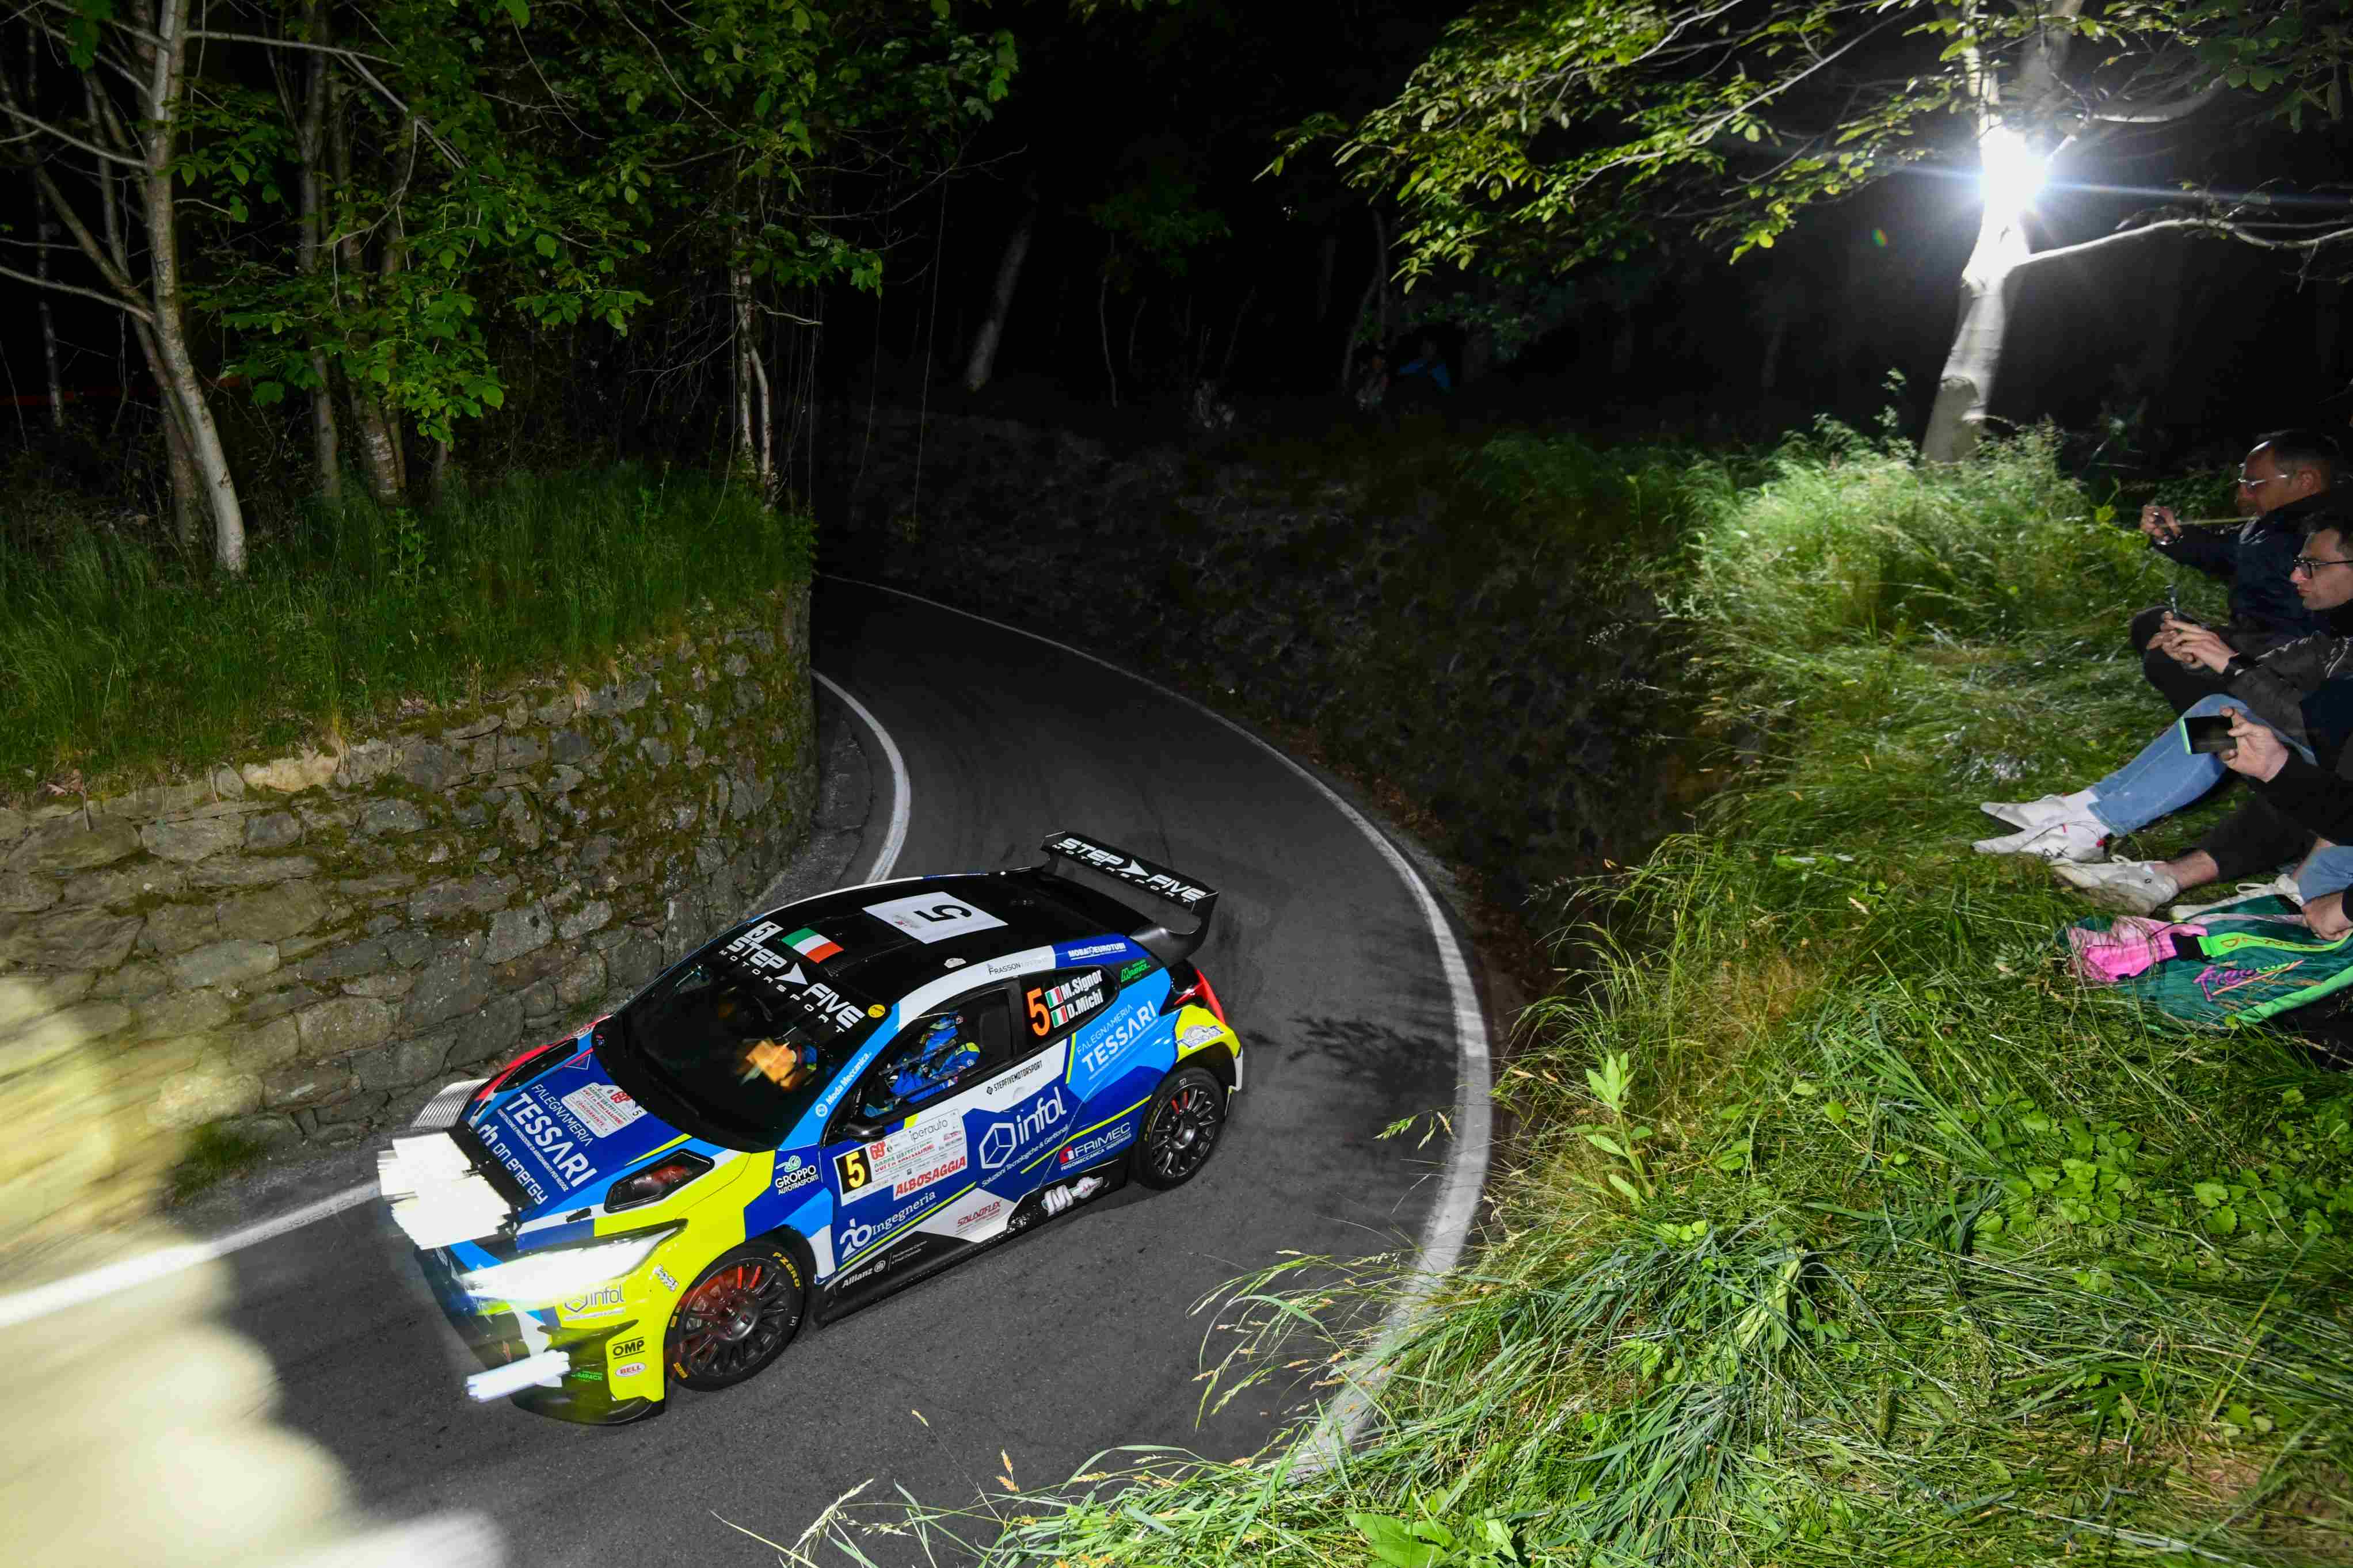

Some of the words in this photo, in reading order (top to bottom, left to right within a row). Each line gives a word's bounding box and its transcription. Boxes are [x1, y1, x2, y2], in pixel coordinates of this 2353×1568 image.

[1052, 844, 1191, 902] MOTORSPORT
[1058, 838, 1124, 865] STEP
[1146, 874, 1207, 902] FIVE
[914, 904, 972, 922] 5
[726, 936, 787, 970] STEP
[802, 982, 866, 1029] FIVE
[988, 963, 1021, 975] FRASSON
[1061, 970, 1103, 1001] M.Signor
[718, 950, 845, 1033] MOTORSPORT
[1067, 991, 1104, 1019] D.Michi
[1027, 987, 1051, 1036] 5
[1076, 1004, 1134, 1055] FALEGNAMERIA
[1081, 1000, 1157, 1073] TESSARI
[531, 1084, 594, 1147] FALEGNAMERIA
[909, 1119, 949, 1142] iperauto
[1016, 1086, 1067, 1144] infol
[493, 1142, 512, 1161] on
[506, 1093, 597, 1187] TESSARI
[1072, 1122, 1131, 1159] FRIMEC
[775, 1165, 816, 1187] GROPPO
[778, 1174, 819, 1195] AUTOTRASPORTI
[846, 1151, 866, 1189] 5
[895, 1155, 966, 1197] ALBOSAGGIA
[872, 1192, 936, 1235] Ingegneria
[842, 1267, 873, 1288] Allianz
[612, 1340, 645, 1356] OMP
[620, 1365, 642, 1374] BELL
